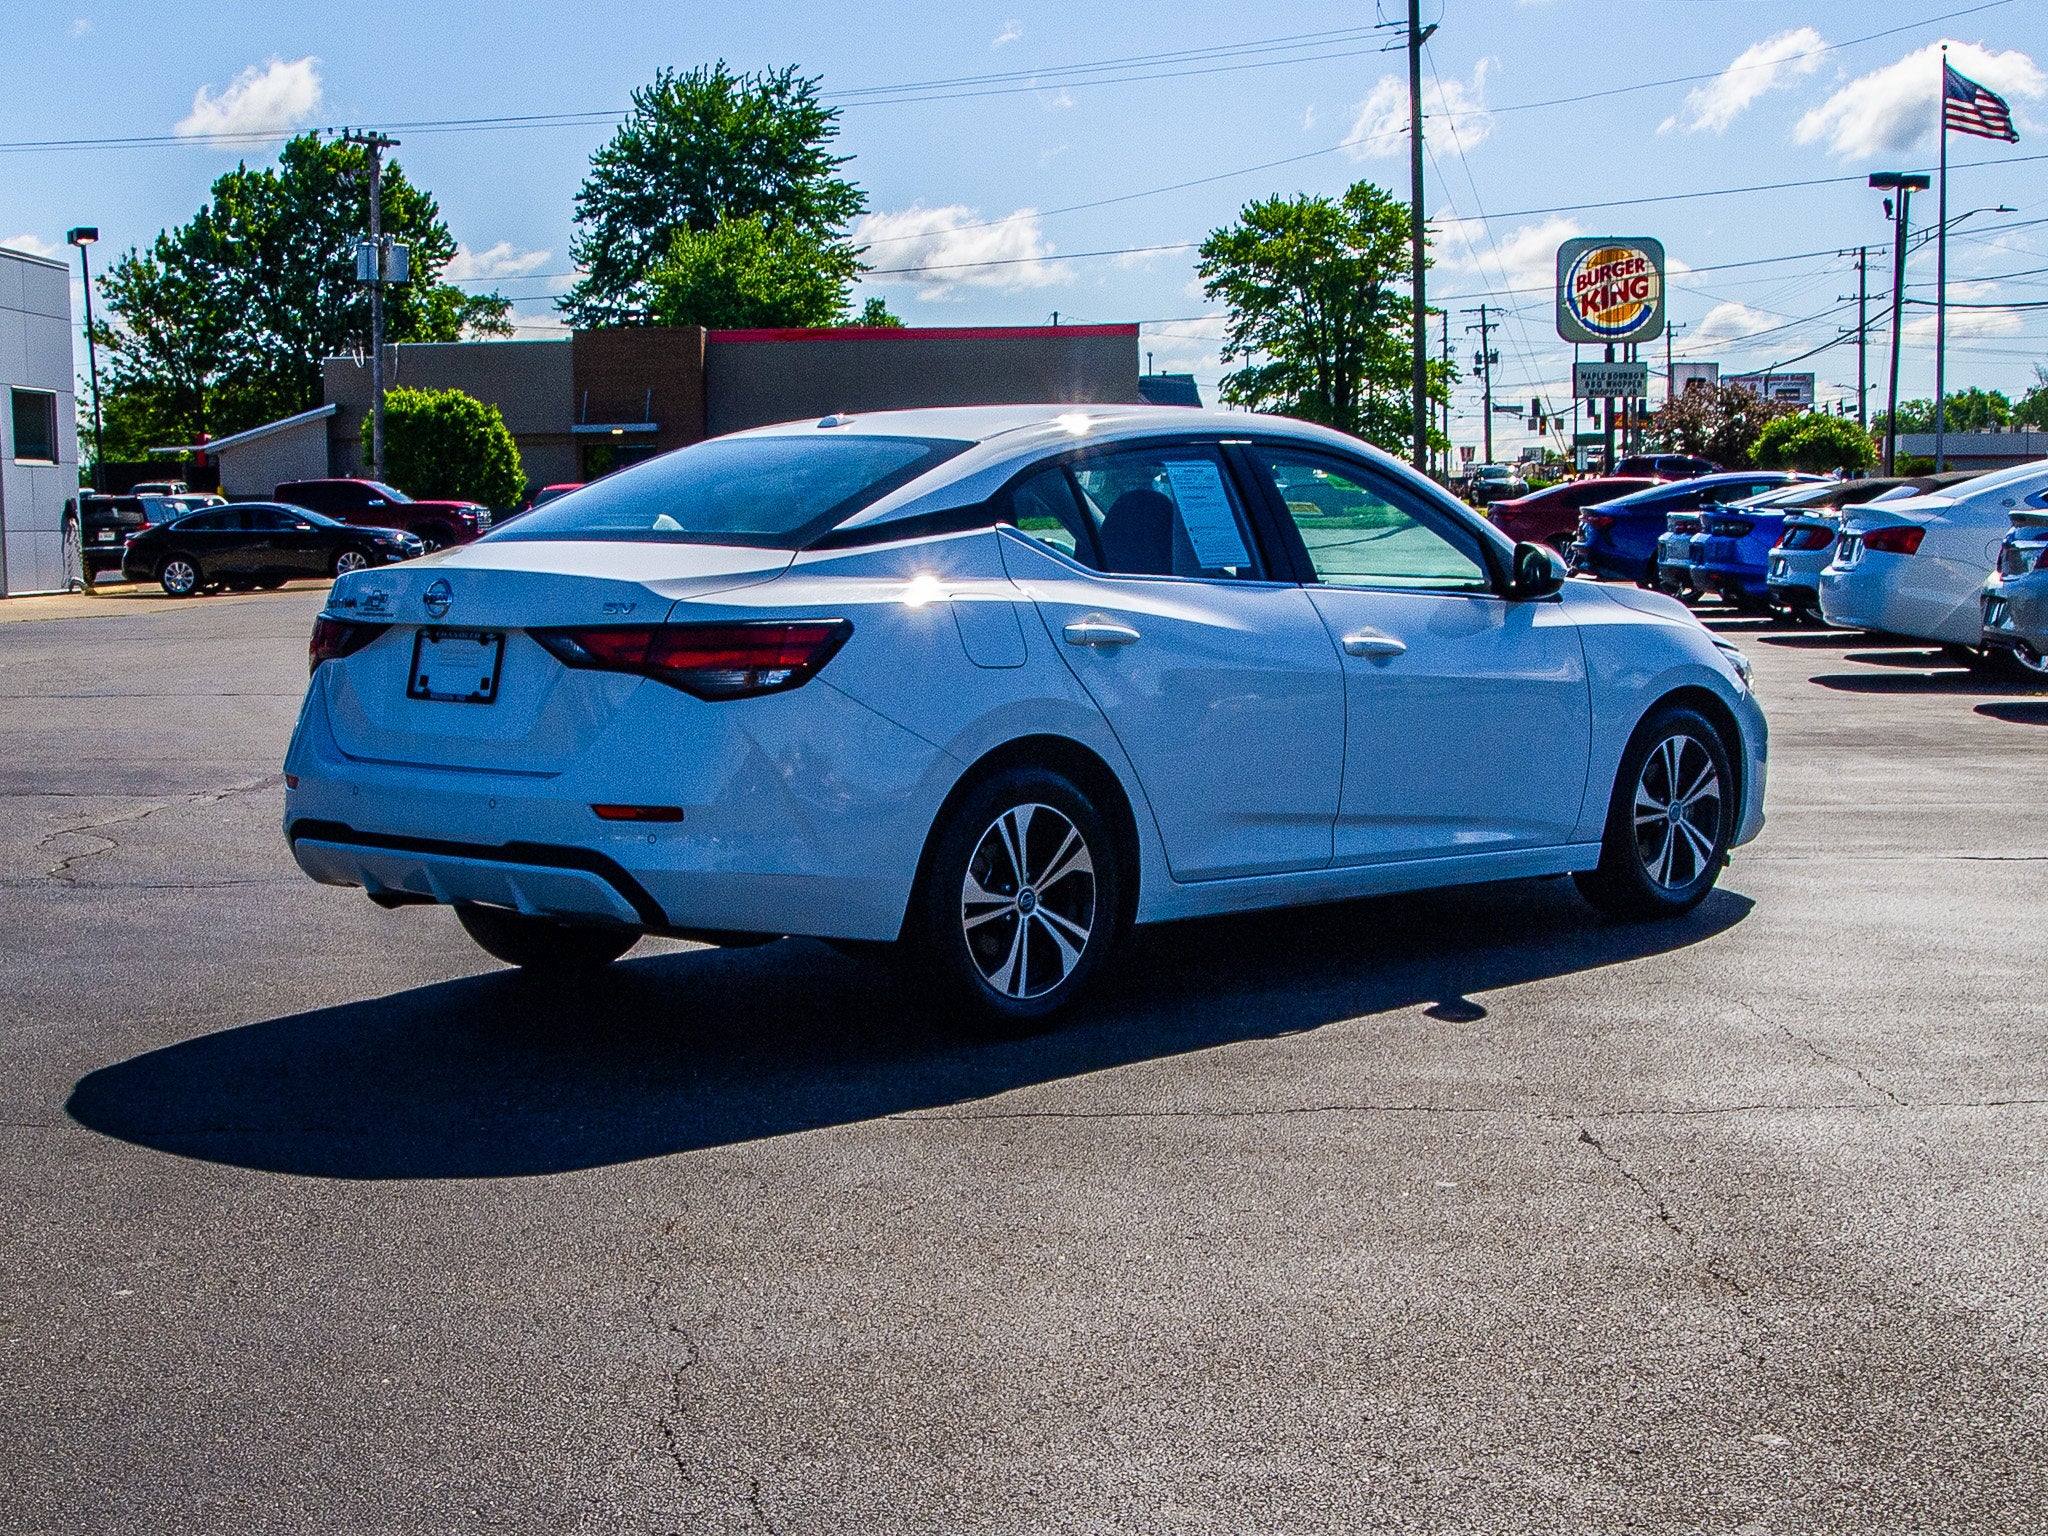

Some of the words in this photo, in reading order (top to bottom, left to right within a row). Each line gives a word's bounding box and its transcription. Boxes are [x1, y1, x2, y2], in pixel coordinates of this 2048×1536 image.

[1576, 257, 1646, 293] BURGER
[1580, 276, 1649, 318] KING
[1580, 371, 1606, 380] MAPLE
[1606, 379, 1643, 388] WHOPPER
[1588, 388, 1624, 397] WHOPPER
[602, 601, 637, 615] SV
